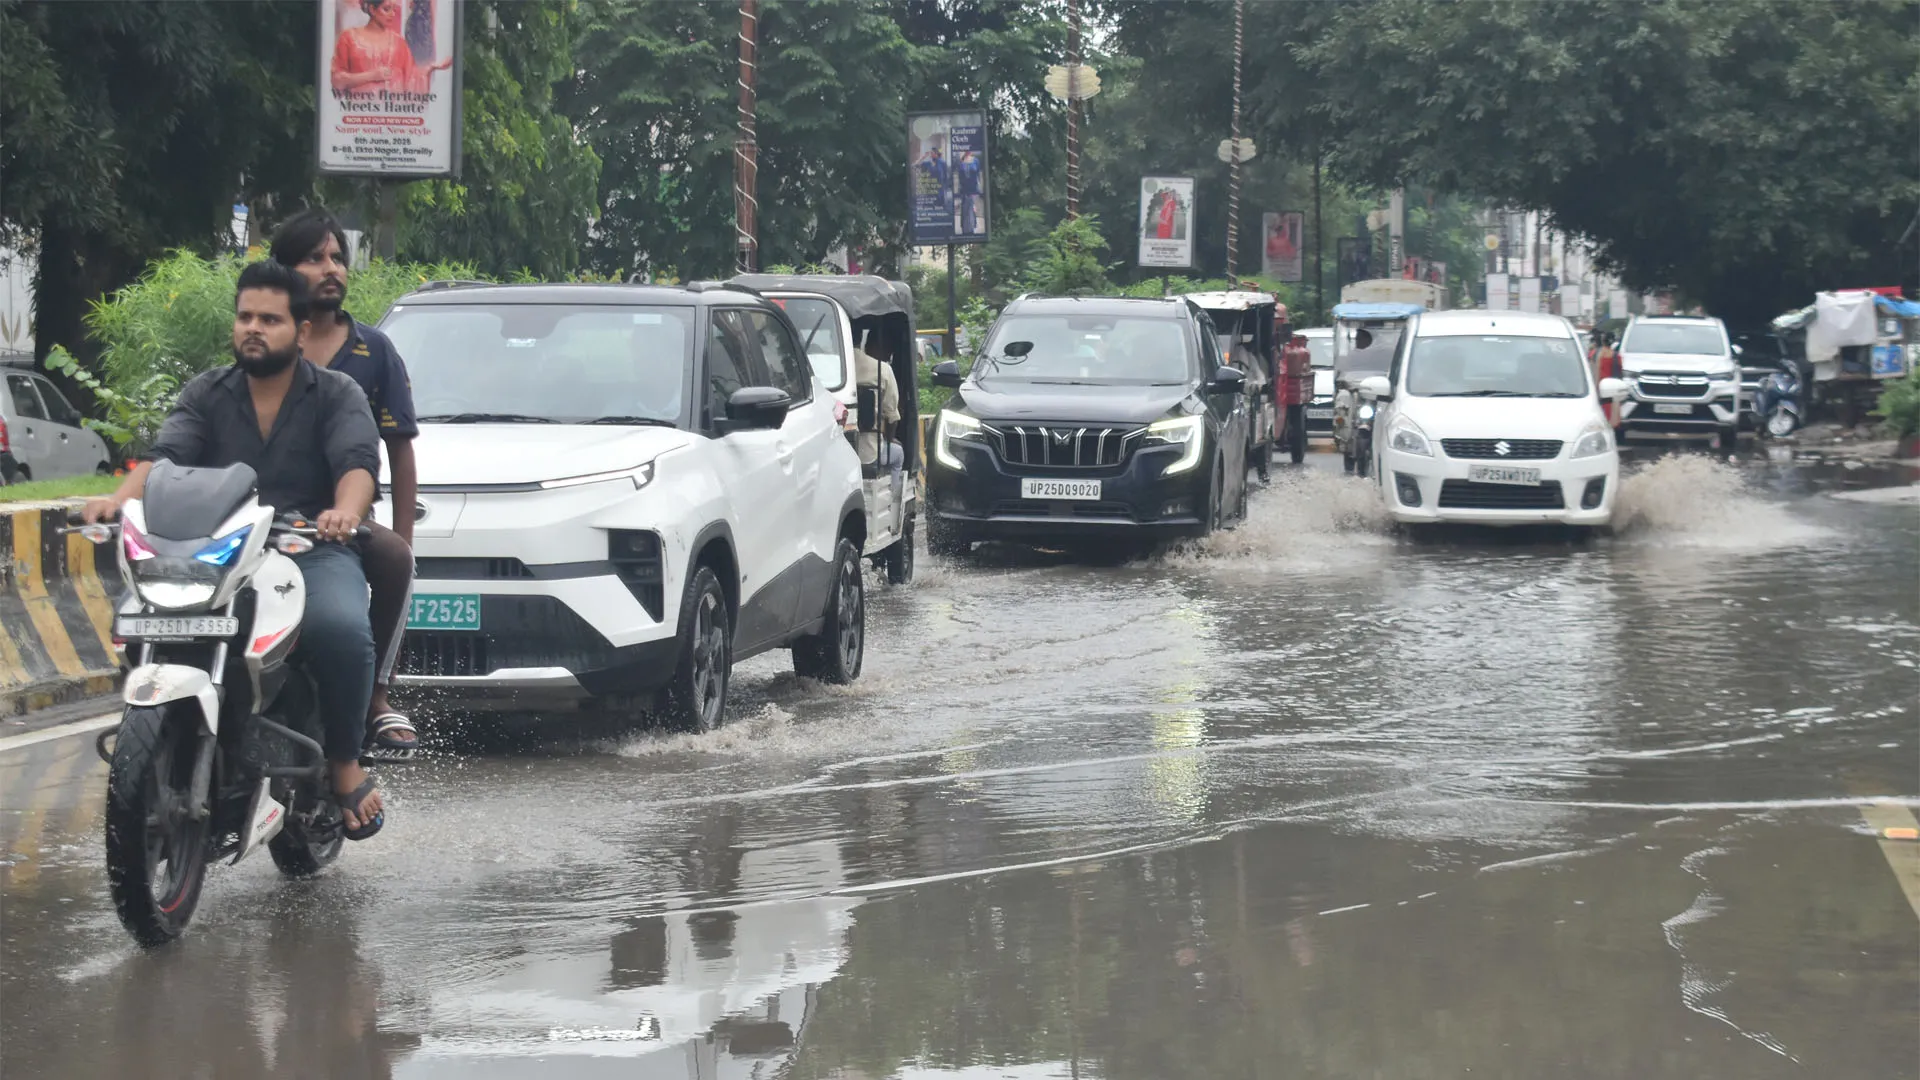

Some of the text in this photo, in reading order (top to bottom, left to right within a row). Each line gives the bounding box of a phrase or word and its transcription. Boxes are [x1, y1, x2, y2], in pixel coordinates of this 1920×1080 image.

[331, 87, 437, 104] Where Heritage
[340, 101, 424, 113] Meets Haute
[335, 126, 359, 134] Same
[388, 127, 405, 135] New
[409, 127, 432, 137] style
[370, 138, 391, 146] June,
